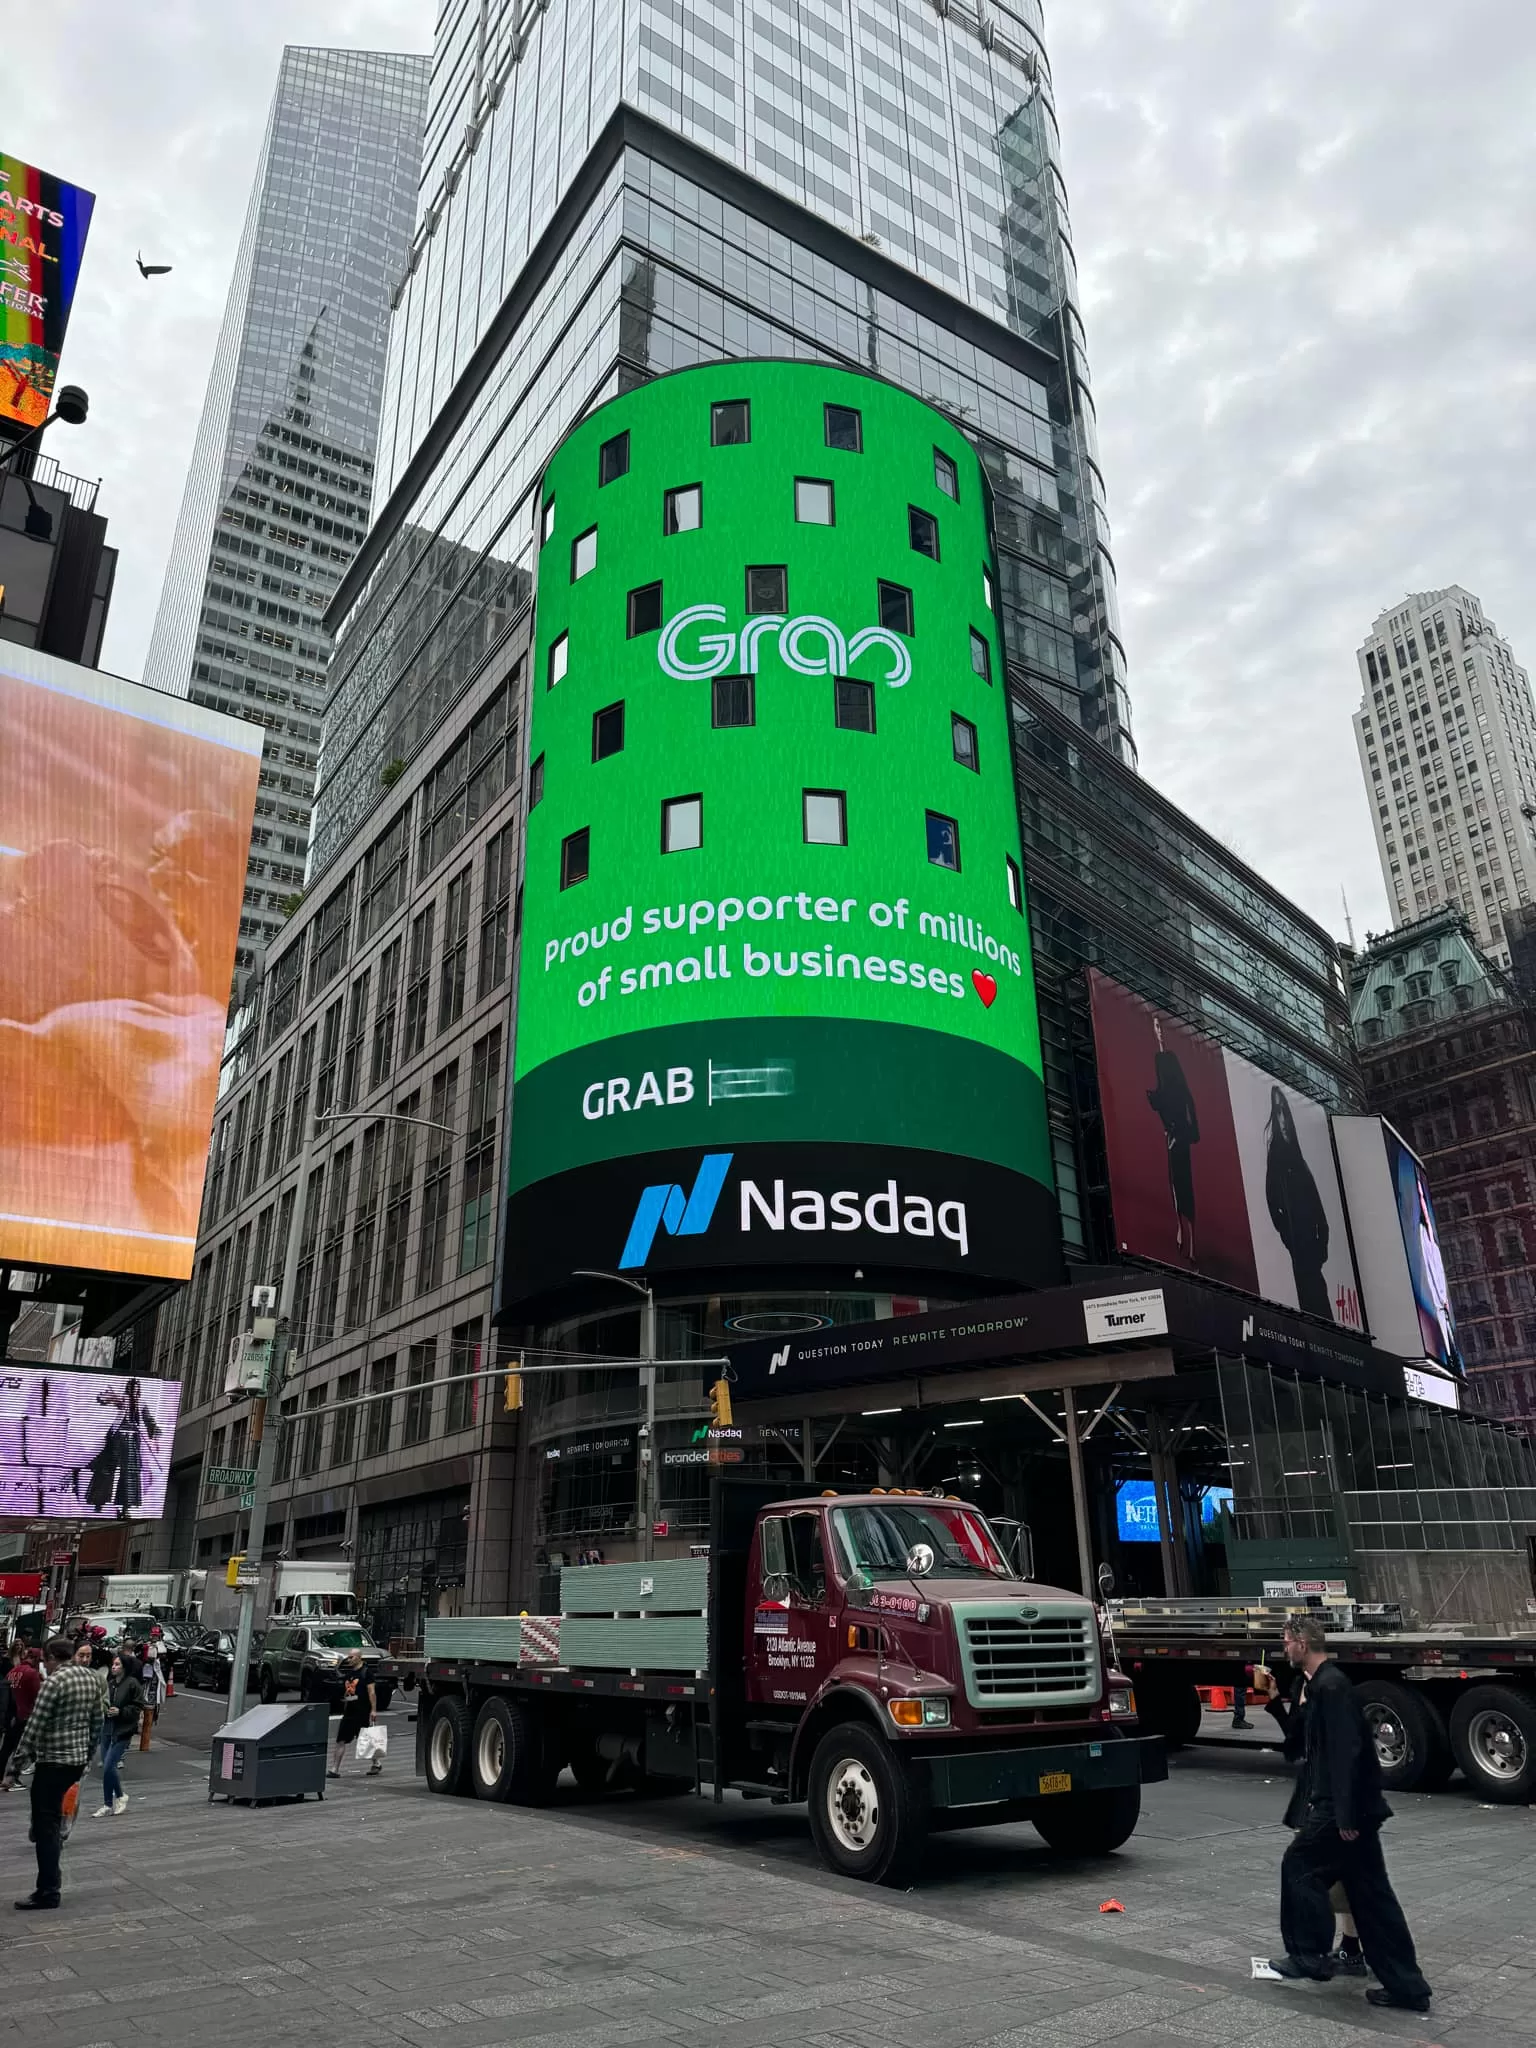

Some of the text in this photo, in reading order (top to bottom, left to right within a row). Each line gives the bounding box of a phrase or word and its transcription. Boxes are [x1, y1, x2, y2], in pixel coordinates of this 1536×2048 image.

[546, 893, 1021, 976] Proud supporter of millions
[577, 943, 965, 1007] of small businesses
[582, 1066, 694, 1120] GRAB
[740, 1179, 969, 1257] Nasdaq
[1104, 1313, 1146, 1327] Turner
[798, 1344, 847, 1360] QUESTION
[851, 1338, 884, 1352] TODAY
[893, 1329, 946, 1346] REWRITE
[1258, 1327, 1288, 1344] QUESTION
[1288, 1336, 1305, 1349] TODAY
[708, 1428, 742, 1439] Nasdaq
[209, 1468, 252, 1485] BROADWAY
[766, 1636, 816, 1653] 2120 Atlantic Avenue
[768, 1654, 815, 1670] Brooklyn, NY 11233
